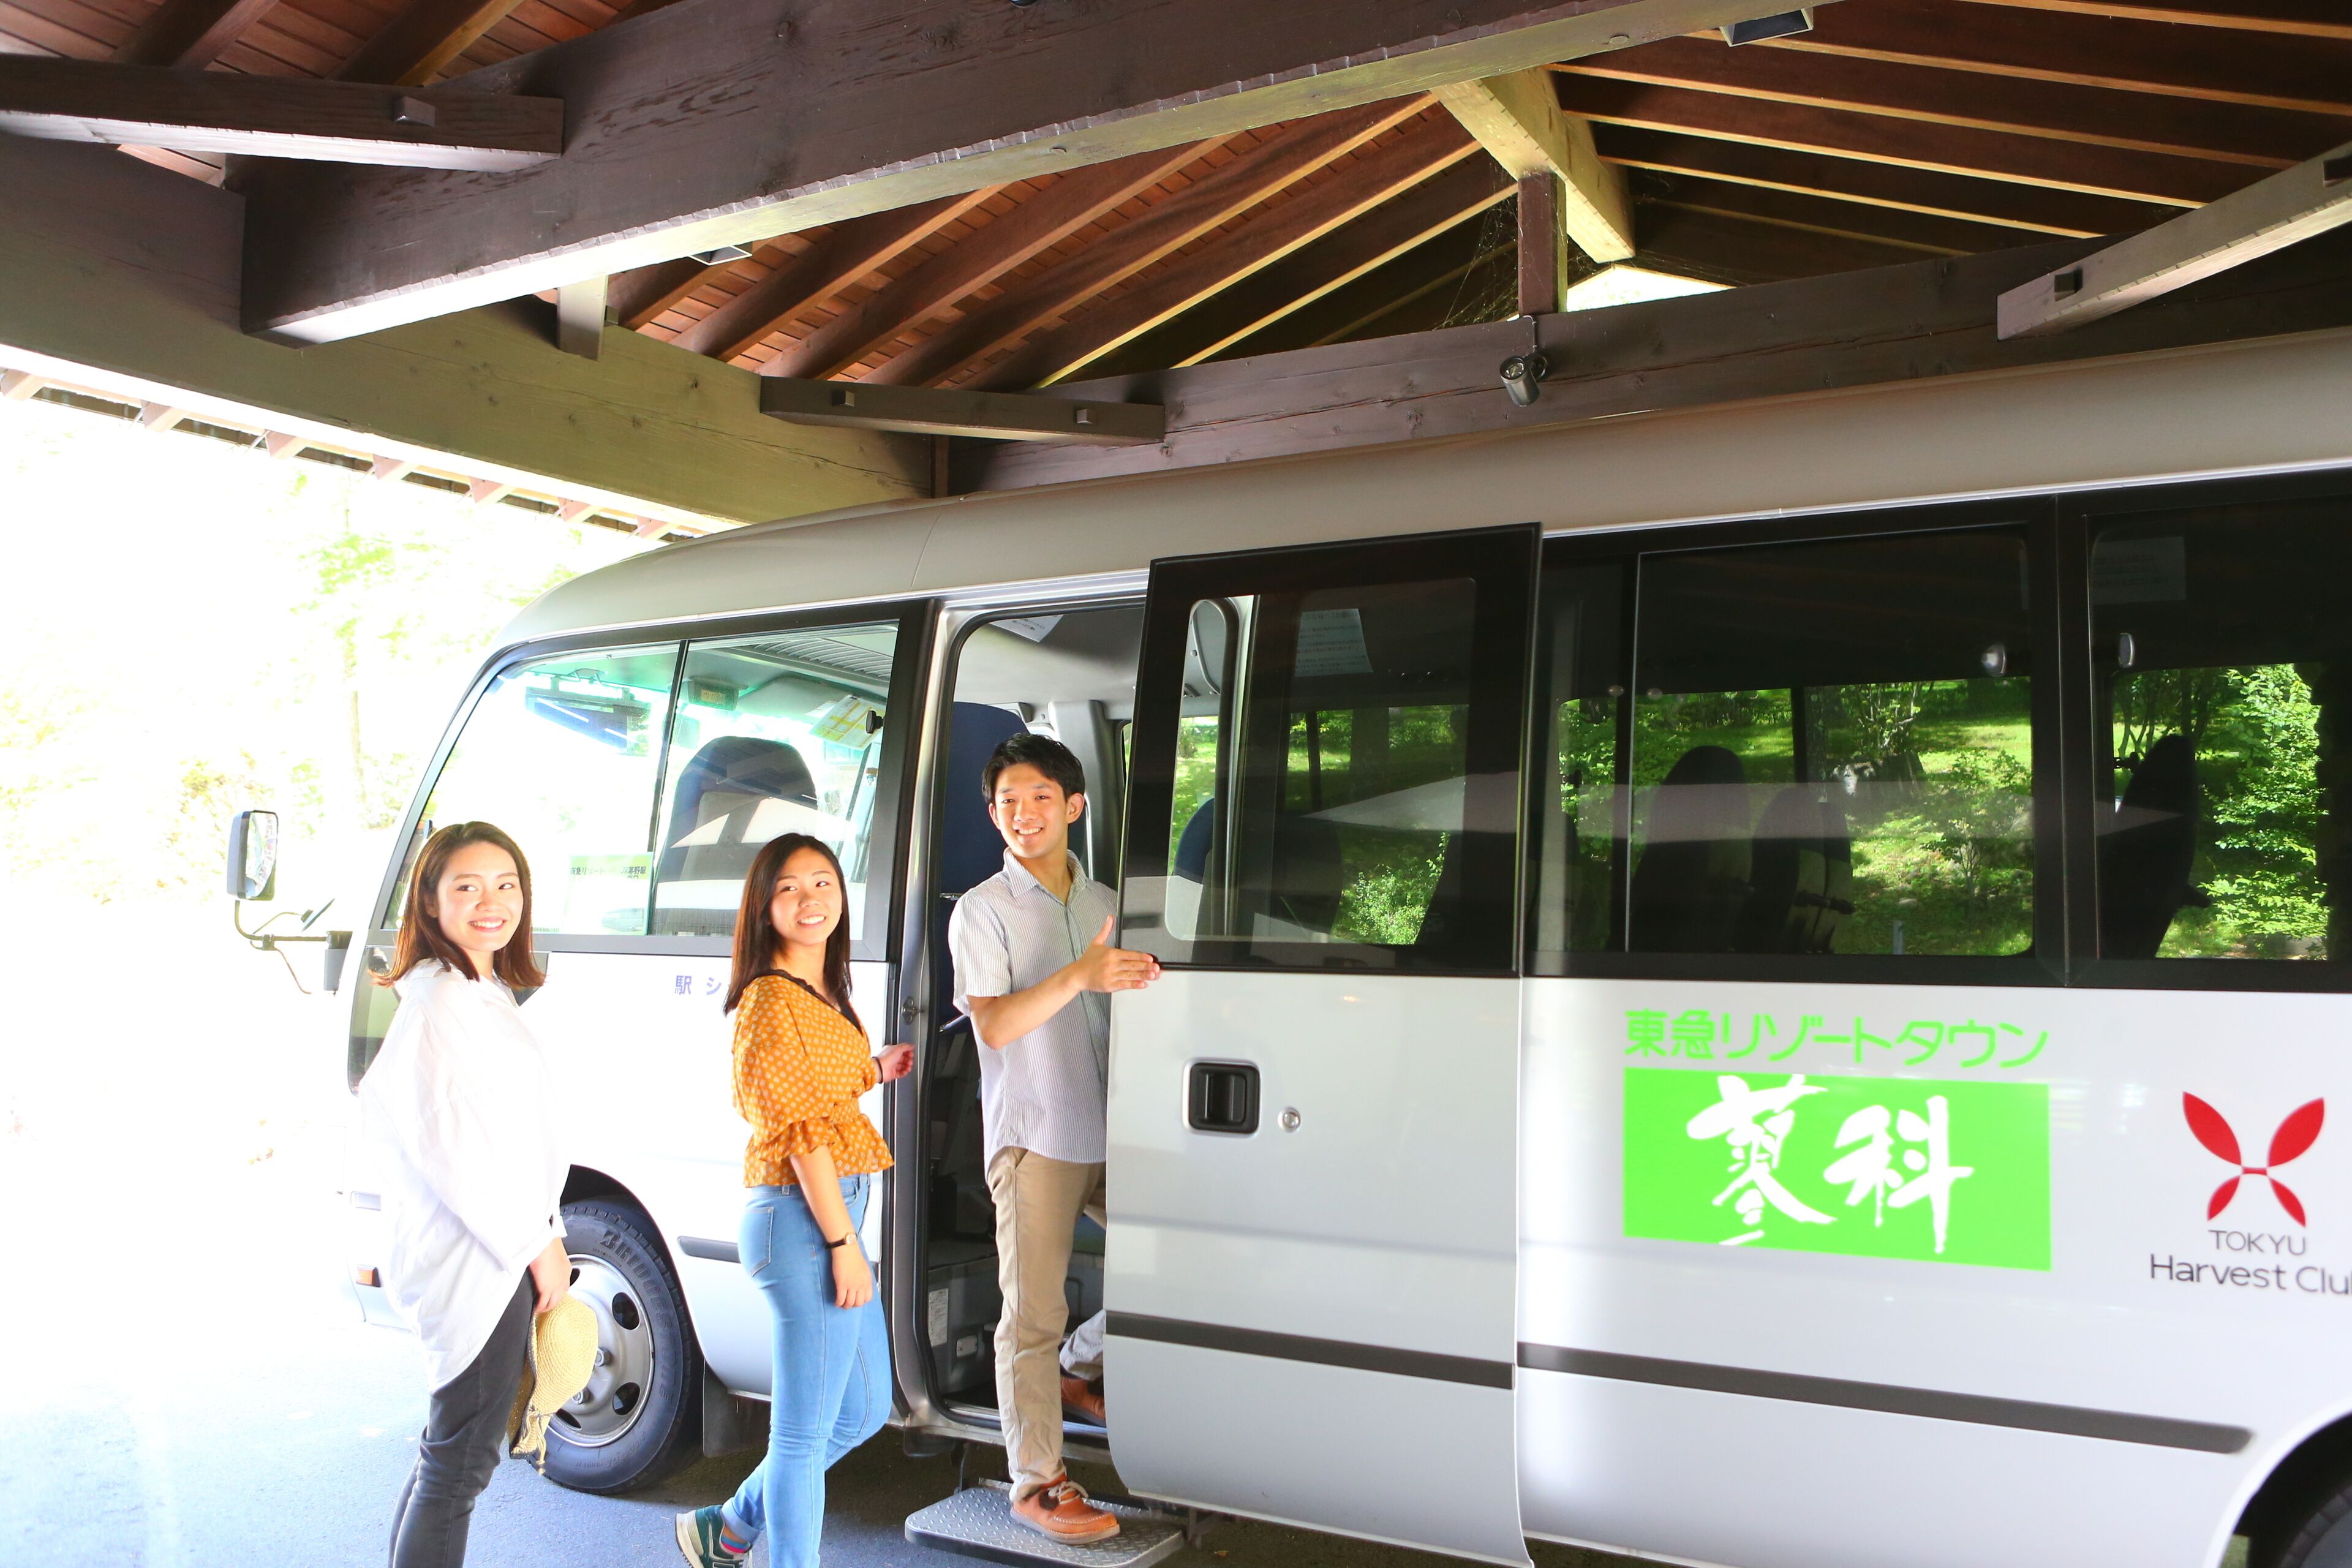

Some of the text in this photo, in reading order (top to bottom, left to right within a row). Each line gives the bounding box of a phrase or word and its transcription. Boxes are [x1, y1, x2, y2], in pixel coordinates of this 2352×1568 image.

[1624, 1008, 2049, 1068] 東急リゾートタウン
[1686, 1072, 1975, 1254] 蓼科
[2207, 1229, 2307, 1256] TOKYU
[2150, 1253, 2352, 1295] Harvest Clu
